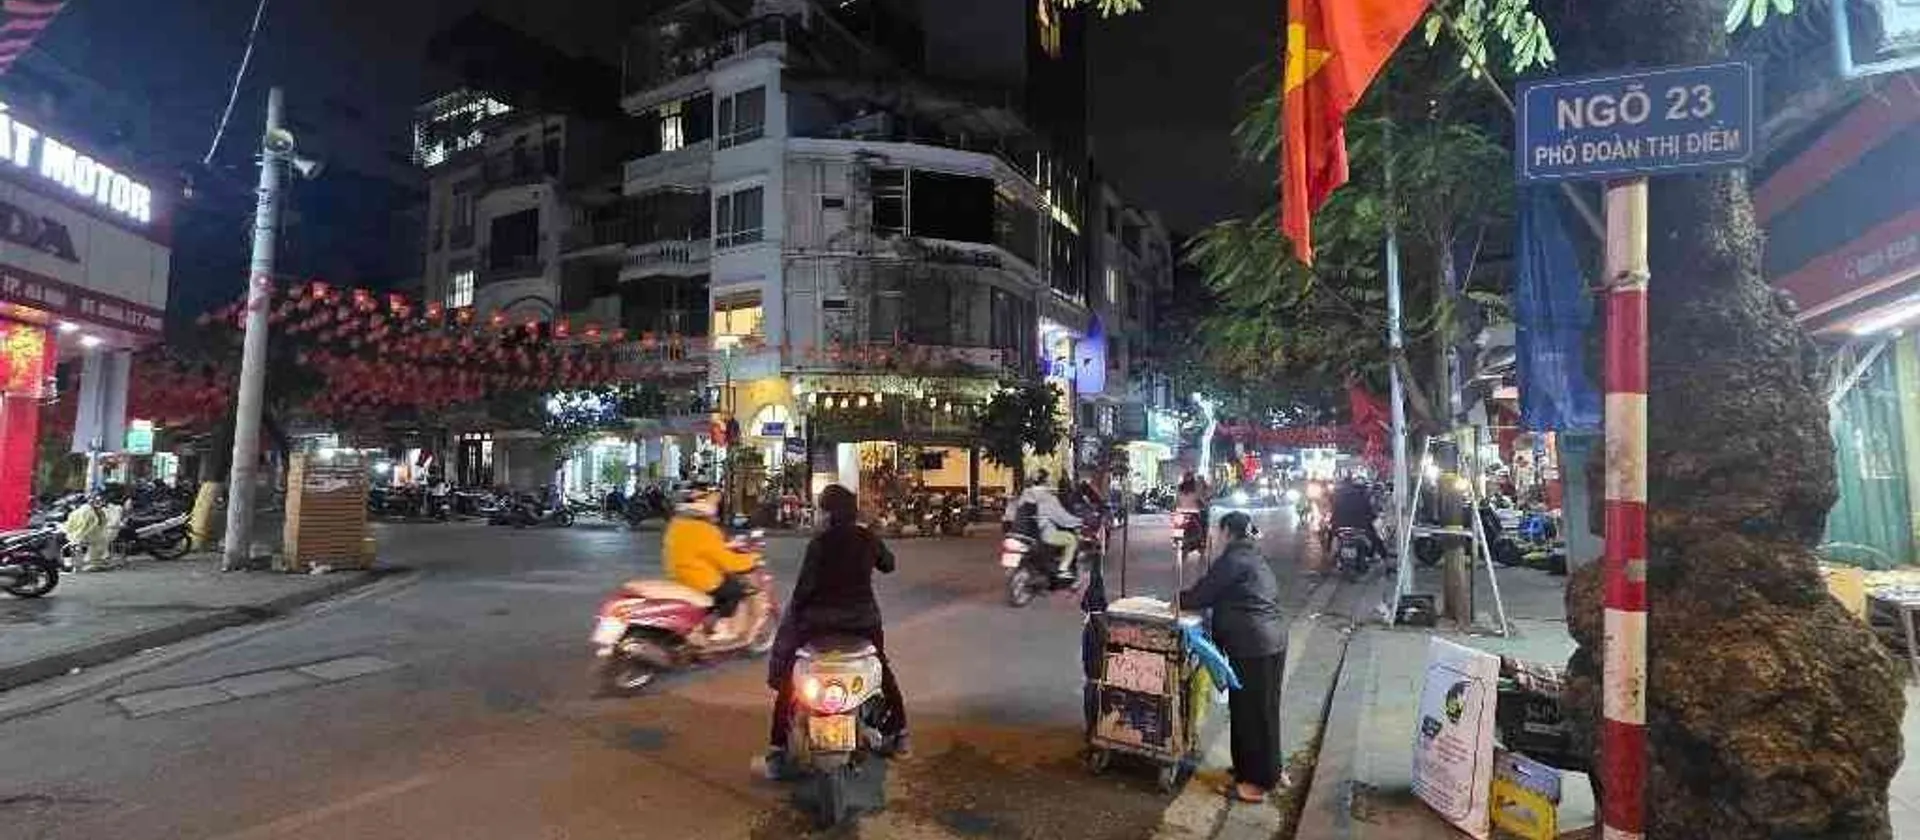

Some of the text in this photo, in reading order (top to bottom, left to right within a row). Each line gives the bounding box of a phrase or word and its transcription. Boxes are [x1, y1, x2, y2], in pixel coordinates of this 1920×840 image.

[1557, 84, 1714, 131] NGÕ 23
[1535, 136, 1577, 167] PHỐ
[1582, 135, 1640, 163] ĐOÀN
[1646, 137, 1680, 160] THỊ
[42, 136, 152, 223] MOTOR
